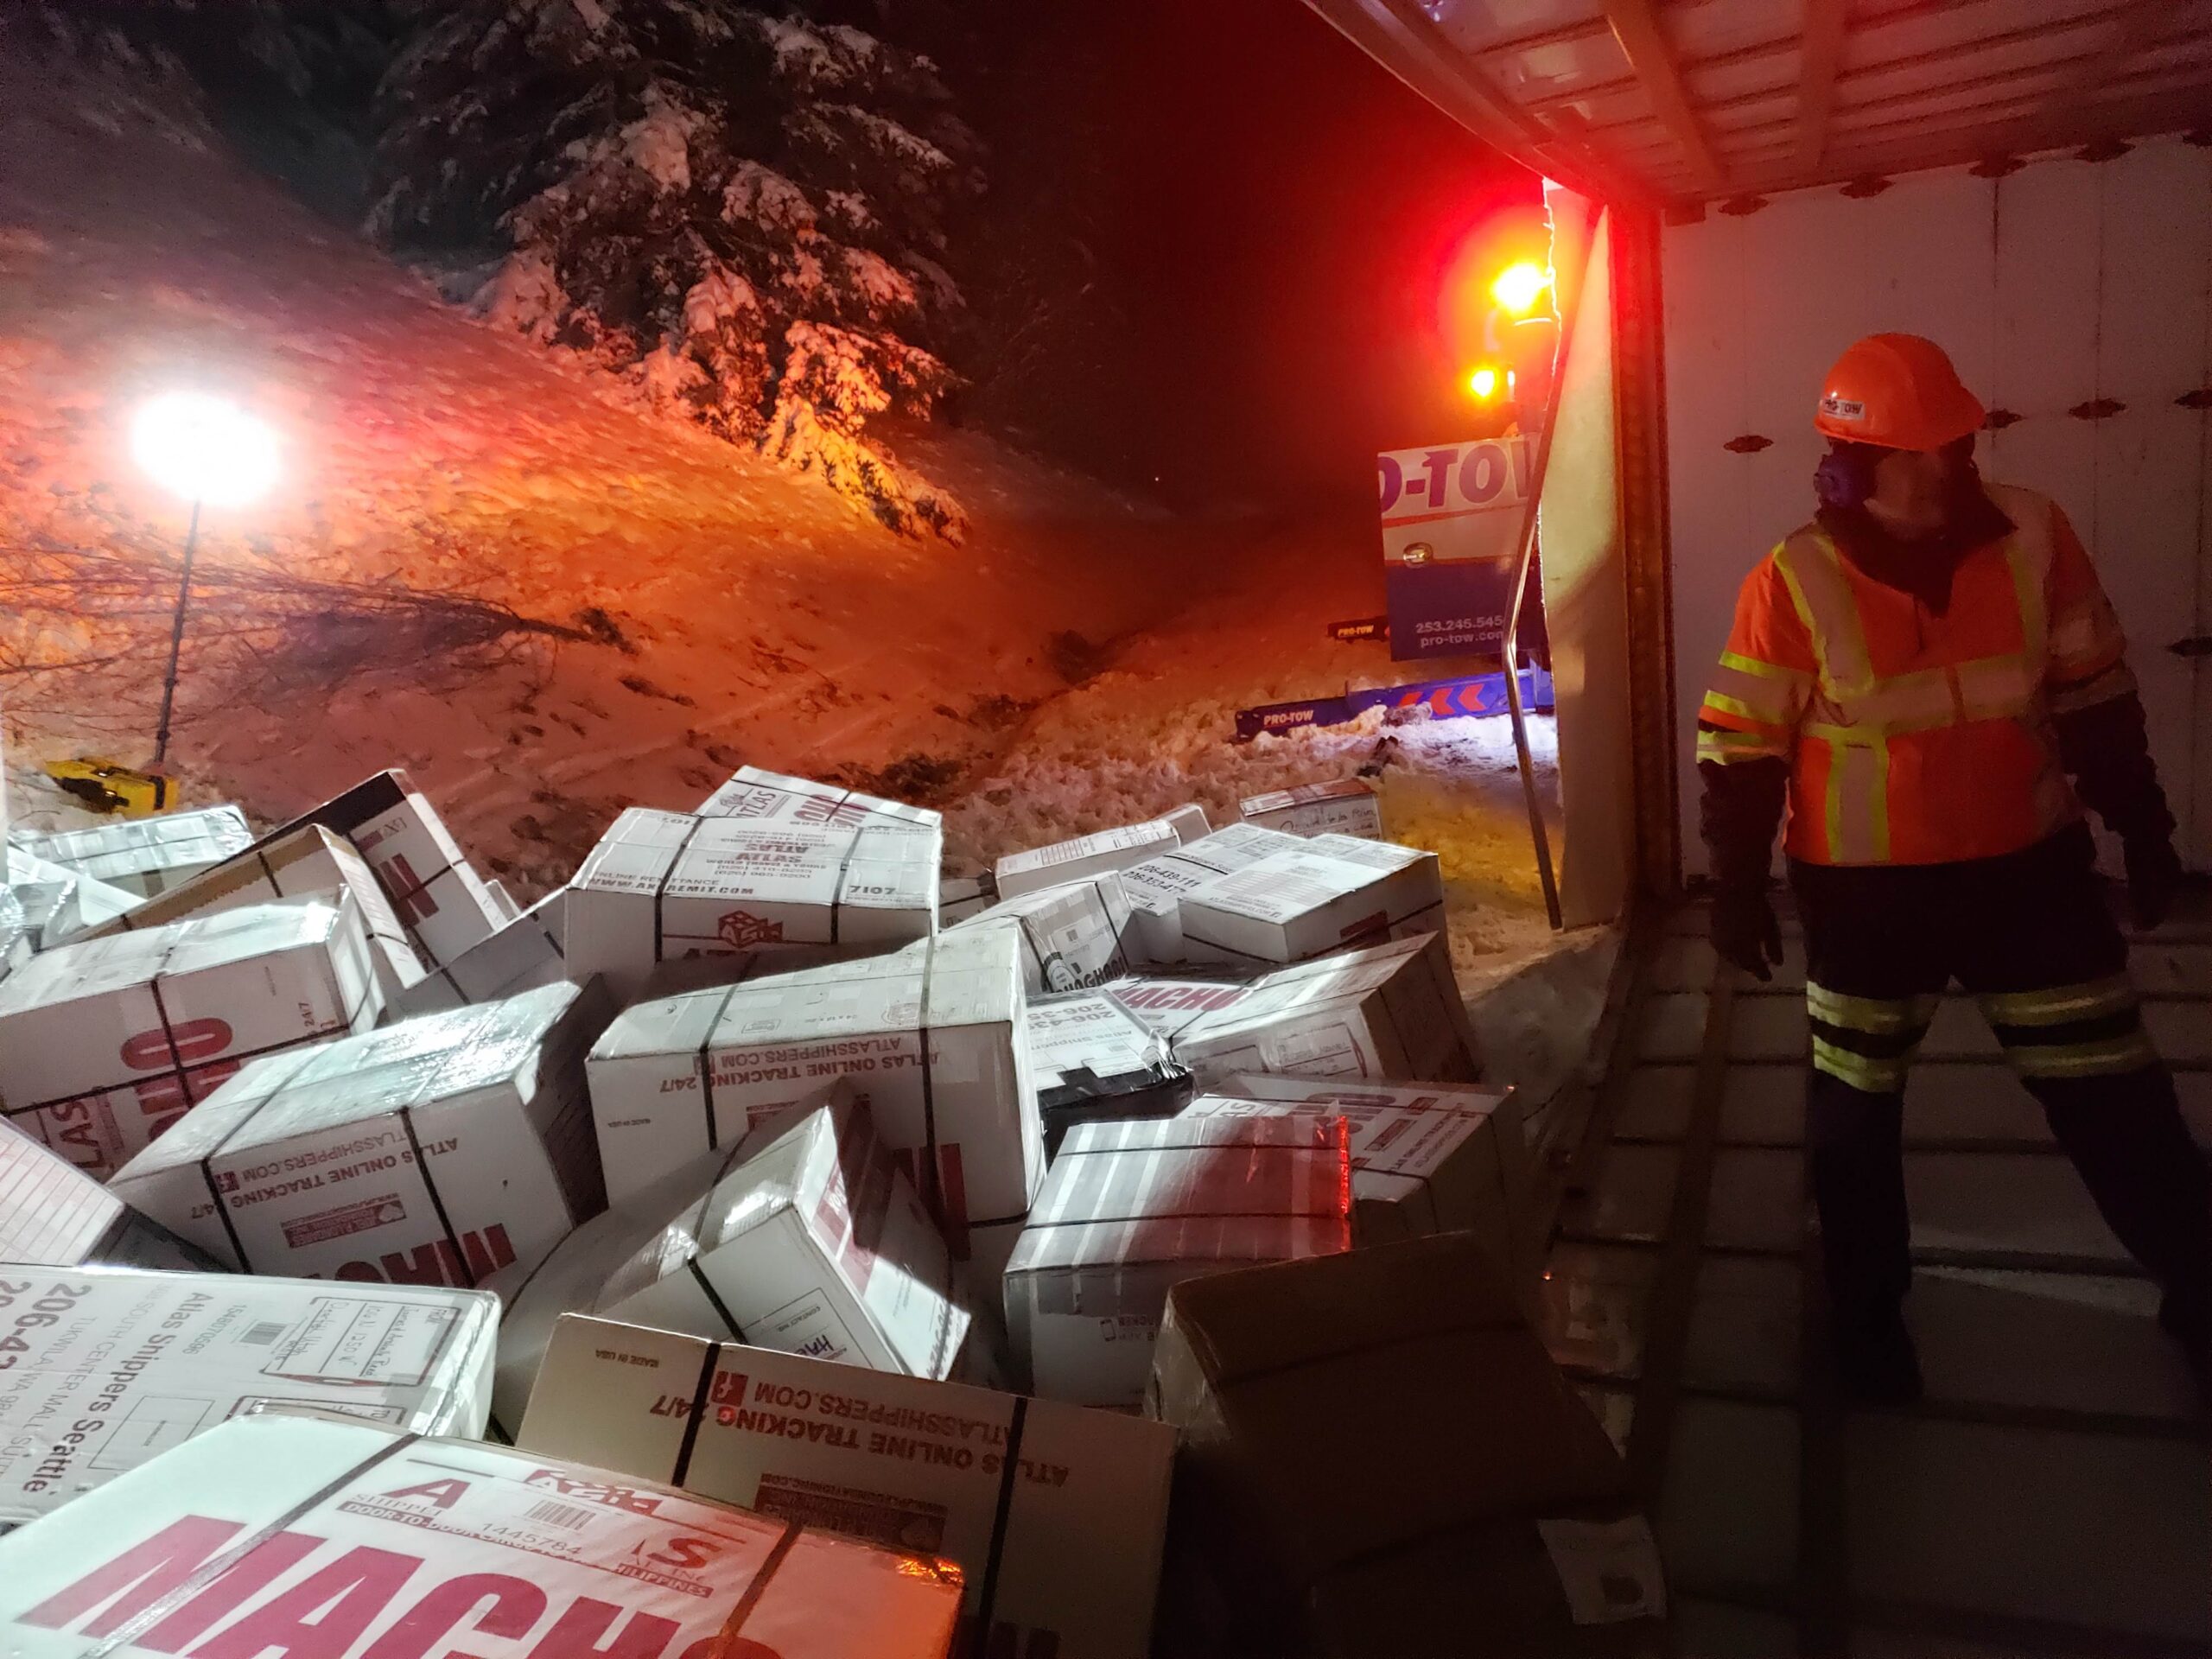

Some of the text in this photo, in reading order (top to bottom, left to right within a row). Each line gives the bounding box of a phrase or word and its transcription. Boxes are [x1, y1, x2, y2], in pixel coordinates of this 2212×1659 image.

[1263, 709, 1314, 726] PRO-TOW
[721, 1038, 901, 1068] ATLASSHIPPERS.COM
[806, 1058, 876, 1077] ONLINE
[660, 1077, 697, 1093] 24/7
[243, 1131, 407, 1182] TLASSHIPPERS.COM
[401, 1137, 458, 1164] ATLS
[327, 1154, 397, 1183] ONLINE
[231, 1174, 325, 1208] TRACKING
[22, 1292, 214, 1493] Atlas Shippers Seattle
[716, 1406, 861, 1450] TRACKING
[868, 1432, 973, 1470] ONLINE
[982, 1453, 1069, 1488] ATLS
[482, 1522, 583, 1554] 1445784
[13, 1514, 782, 1659] MACH
